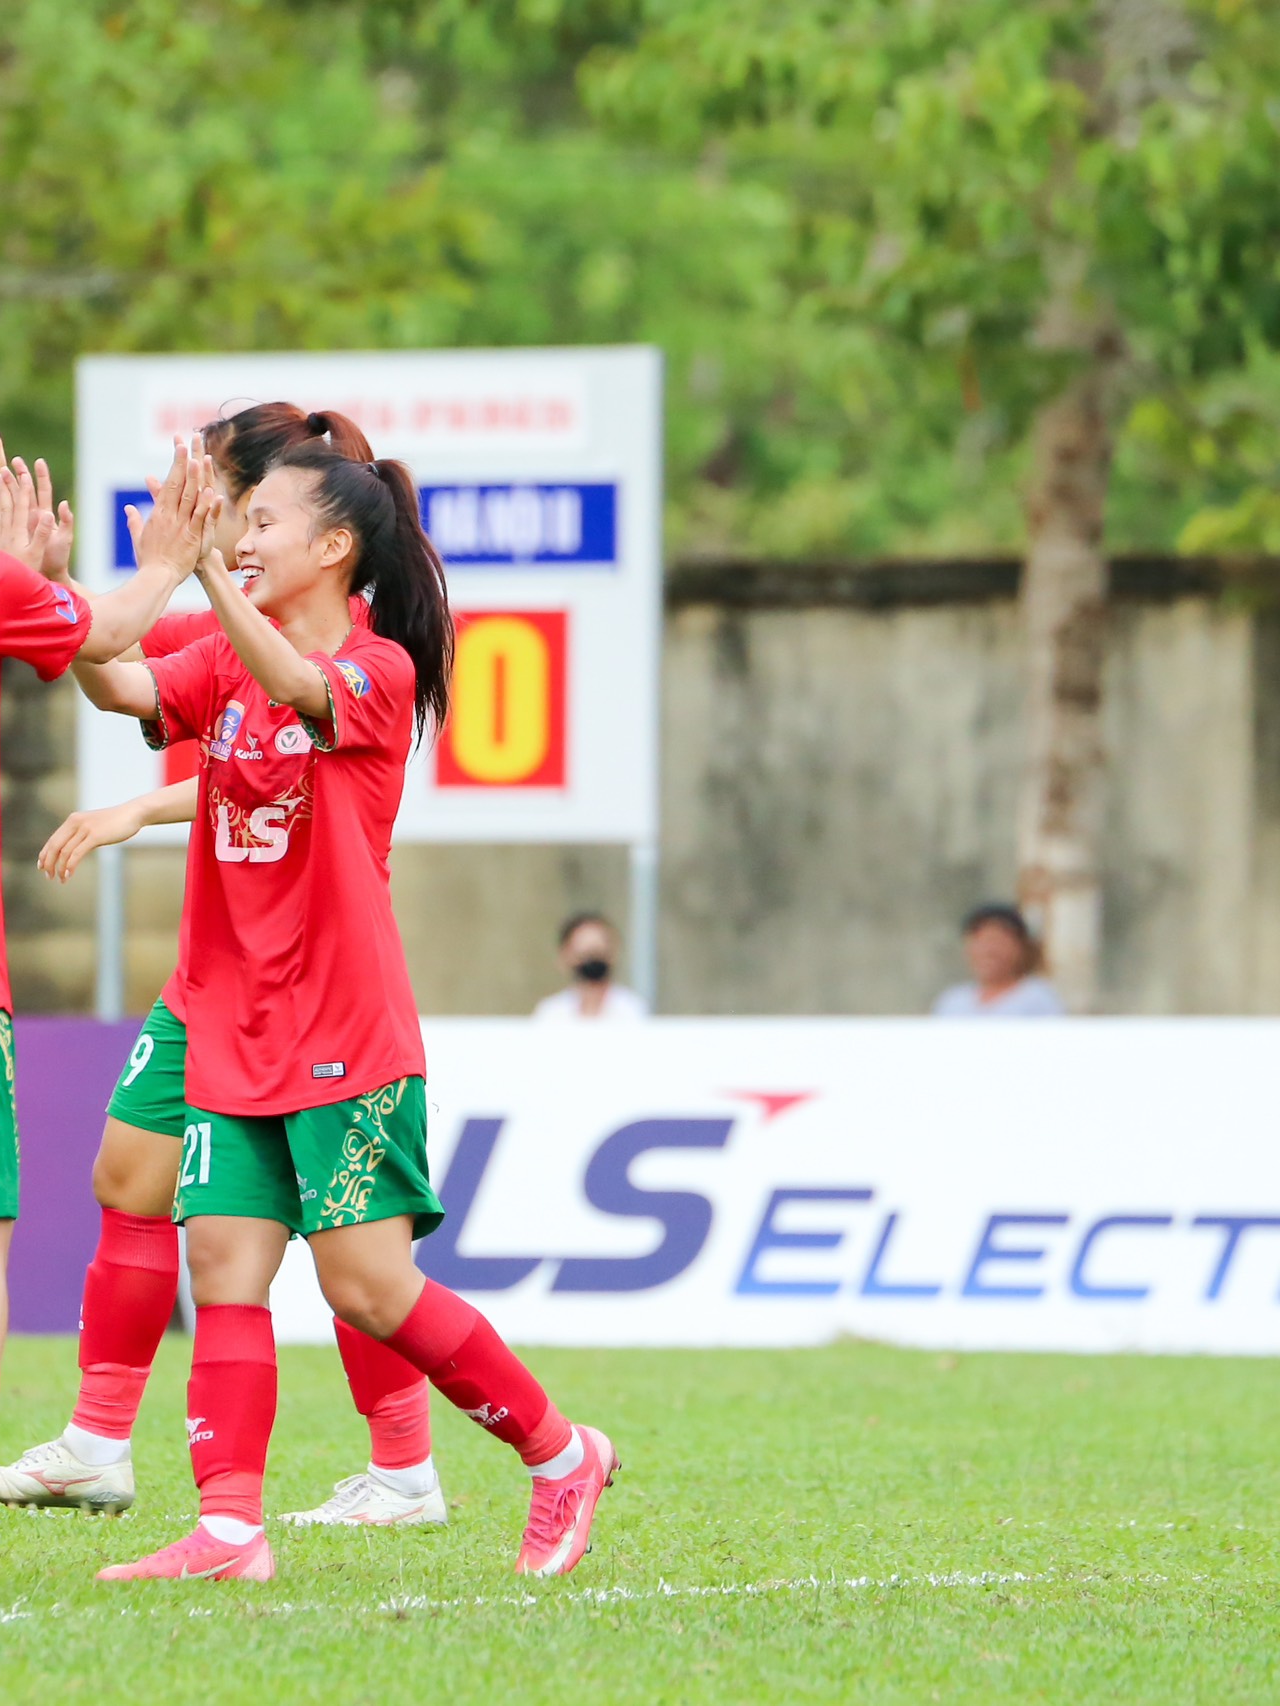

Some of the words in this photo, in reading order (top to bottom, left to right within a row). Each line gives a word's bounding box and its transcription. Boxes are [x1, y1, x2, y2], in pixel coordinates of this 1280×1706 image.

[451, 615, 549, 784] 0
[215, 804, 289, 863] LS
[121, 1033, 155, 1087] 9
[180, 1121, 212, 1188] 21
[414, 1116, 737, 1294] LS
[731, 1186, 1280, 1301] ELECT
